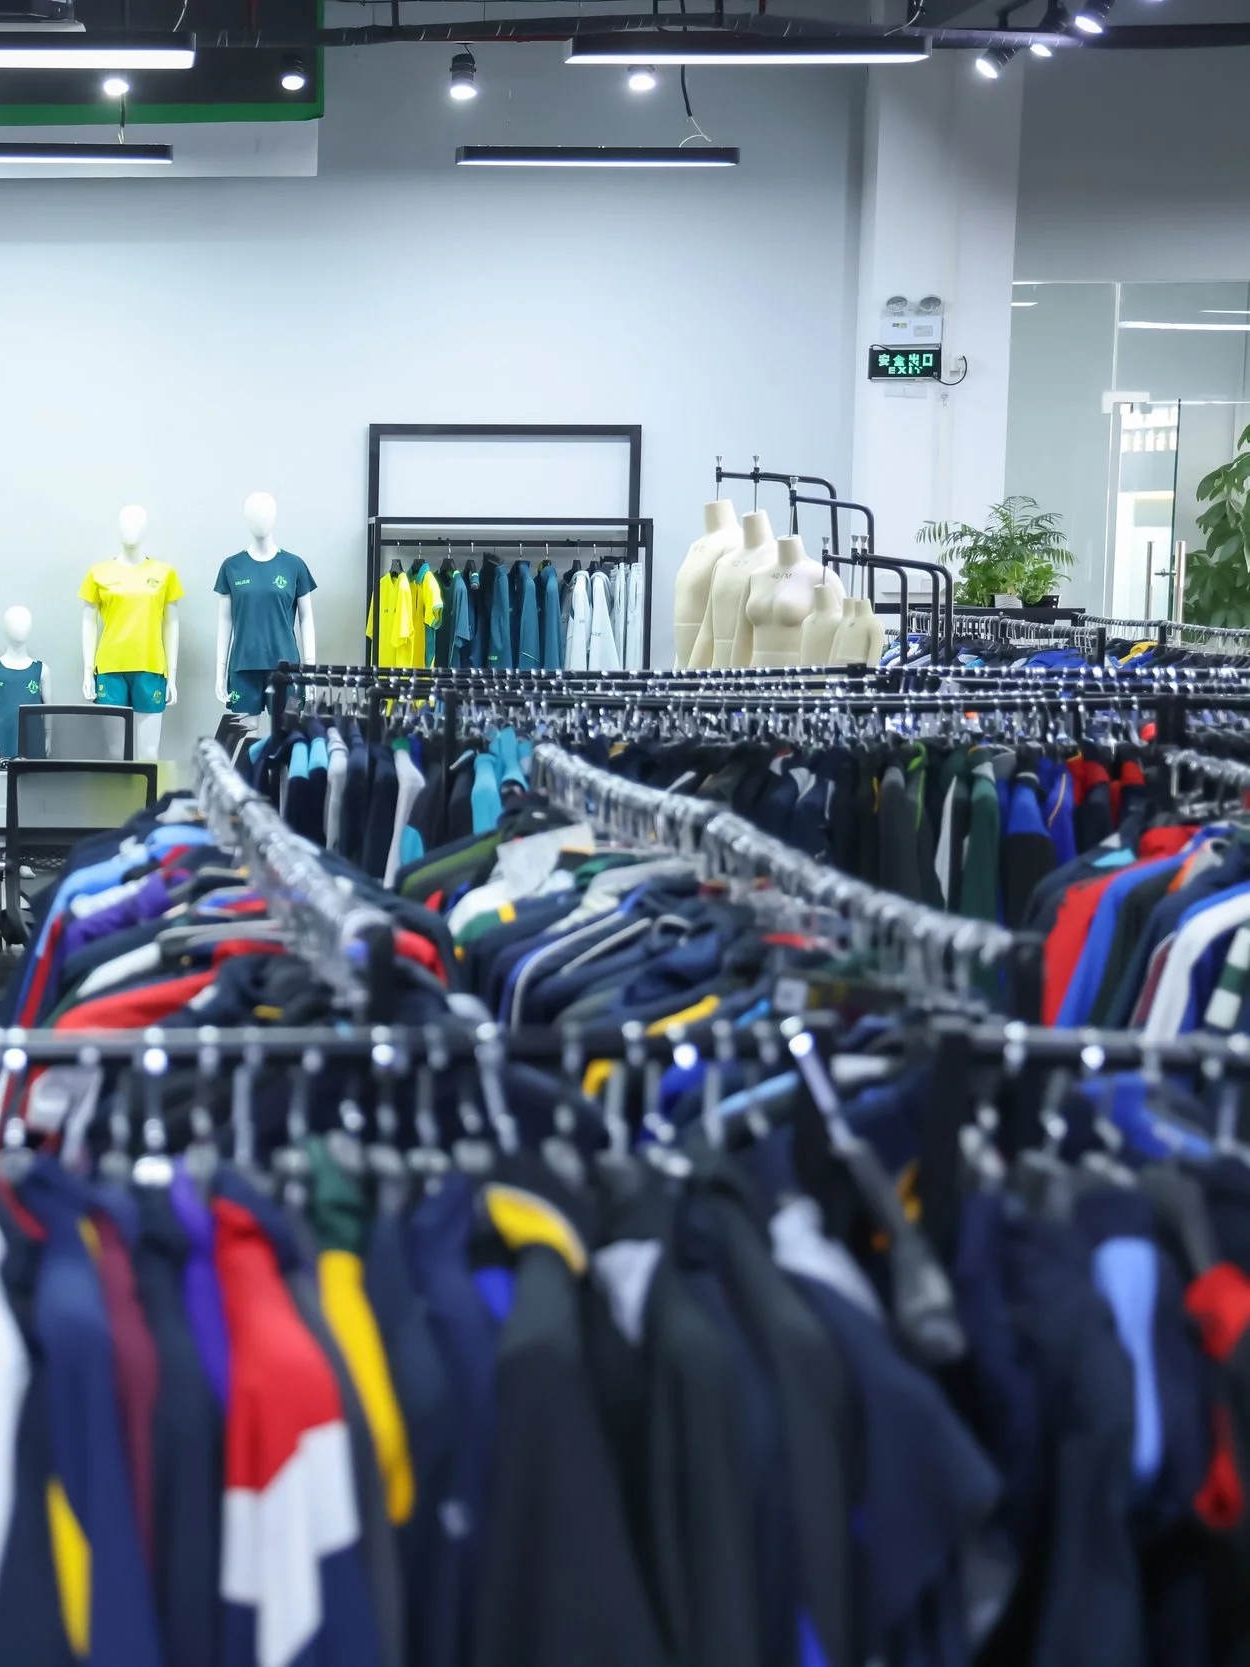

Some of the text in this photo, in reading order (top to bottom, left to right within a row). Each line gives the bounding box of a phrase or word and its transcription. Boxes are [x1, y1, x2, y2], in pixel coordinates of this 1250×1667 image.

[878, 353, 933, 367] 安全出口
[888, 366, 923, 374] EXIT
